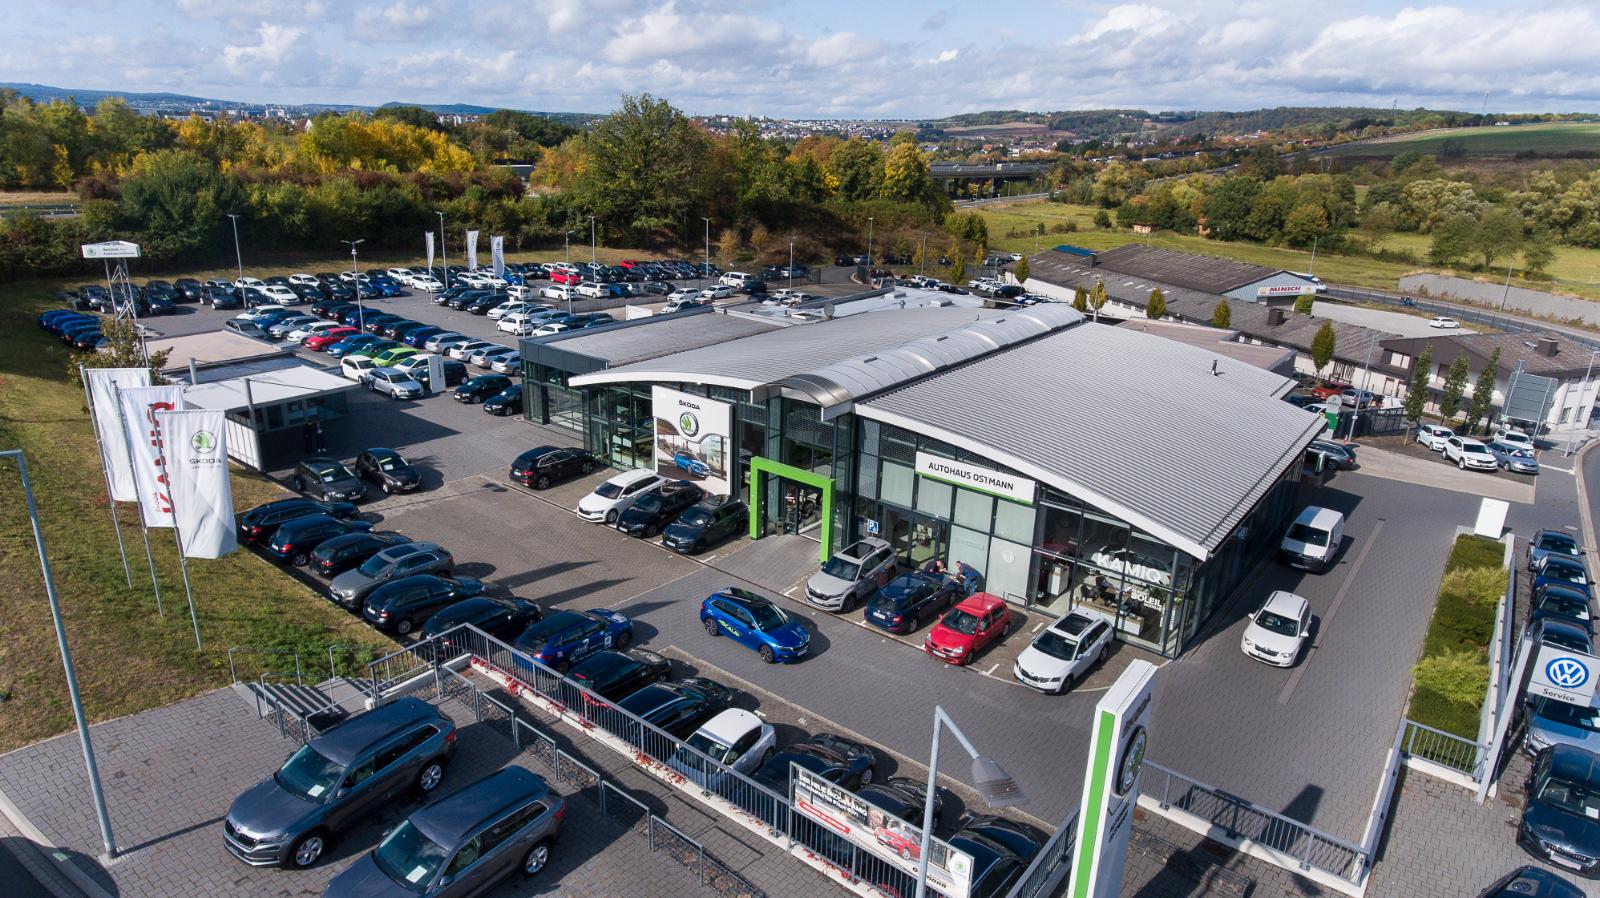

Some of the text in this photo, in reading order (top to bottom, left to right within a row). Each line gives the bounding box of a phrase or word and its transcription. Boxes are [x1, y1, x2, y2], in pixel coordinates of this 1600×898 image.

[928, 461, 1014, 491] AUTOHAUS OSTMANN
[1096, 552, 1162, 584] KAMIQ
[1543, 688, 1575, 702] Service
